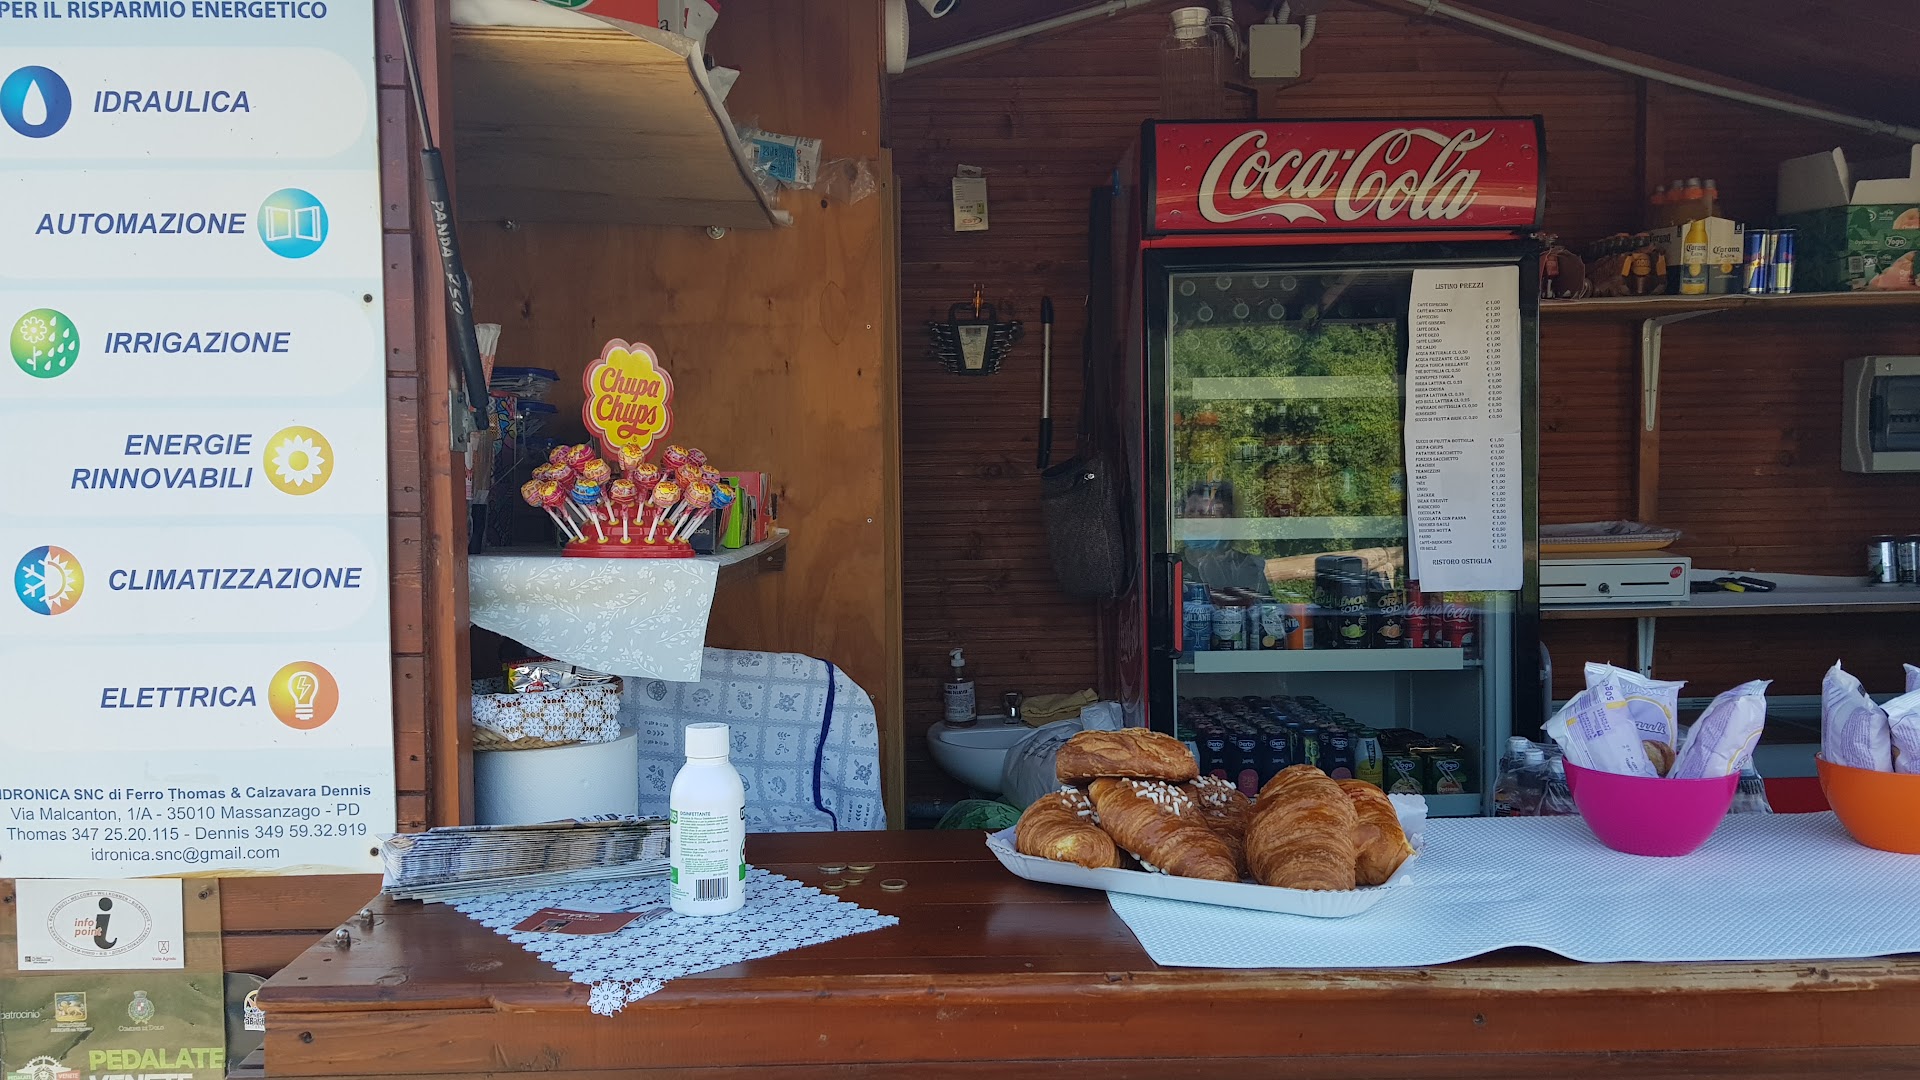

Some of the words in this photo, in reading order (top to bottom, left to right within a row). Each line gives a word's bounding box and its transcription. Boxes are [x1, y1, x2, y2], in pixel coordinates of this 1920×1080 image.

[0, 1, 37, 18] PER
[44, 1, 62, 18] IL
[68, 1, 186, 18] RISPARMIO
[192, 1, 328, 18] ENERGETICO
[94, 90, 251, 113] IDRAULICA
[1198, 127, 1495, 224] Coca-Cola
[36, 212, 247, 235] AUTOMAZIONE
[431, 200, 454, 258] PANDA
[1712, 246, 1740, 254] Corona
[105, 331, 291, 354] IRRIGAZIONE
[599, 367, 660, 403] Chupa
[596, 393, 658, 438] Chups
[124, 433, 253, 456] ENERGIE
[71, 467, 252, 490] RINNOVABILI
[108, 567, 363, 591] CLIMATIZZAZIONE
[1340, 605, 1365, 614] SODA
[100, 686, 258, 708] ELETTRICA
[74, 788, 104, 801] SNC
[109, 788, 122, 800] di
[126, 788, 164, 801] Ferro
[168, 788, 226, 801] Thomas
[230, 787, 239, 798] &
[245, 786, 317, 798] Calzavara
[321, 784, 371, 797] Dennis
[11, 807, 35, 821] Via
[39, 807, 122, 823] Malcanton,
[129, 807, 152, 821] 1/A
[167, 806, 215, 820] 35010
[221, 805, 320, 823] Massanzago
[336, 803, 360, 817] PD
[7, 827, 67, 841] Thomas
[72, 827, 98, 841] 347
[105, 827, 179, 841] 25.20.115
[195, 826, 250, 840] Dennis
[255, 825, 284, 839] 349
[289, 823, 367, 839] 59.32.919
[91, 847, 280, 864] idronica.snc@gmail.com
[74, 917, 95, 927] info
[74, 926, 103, 938] point
[88, 1047, 225, 1071] PEDALATE
